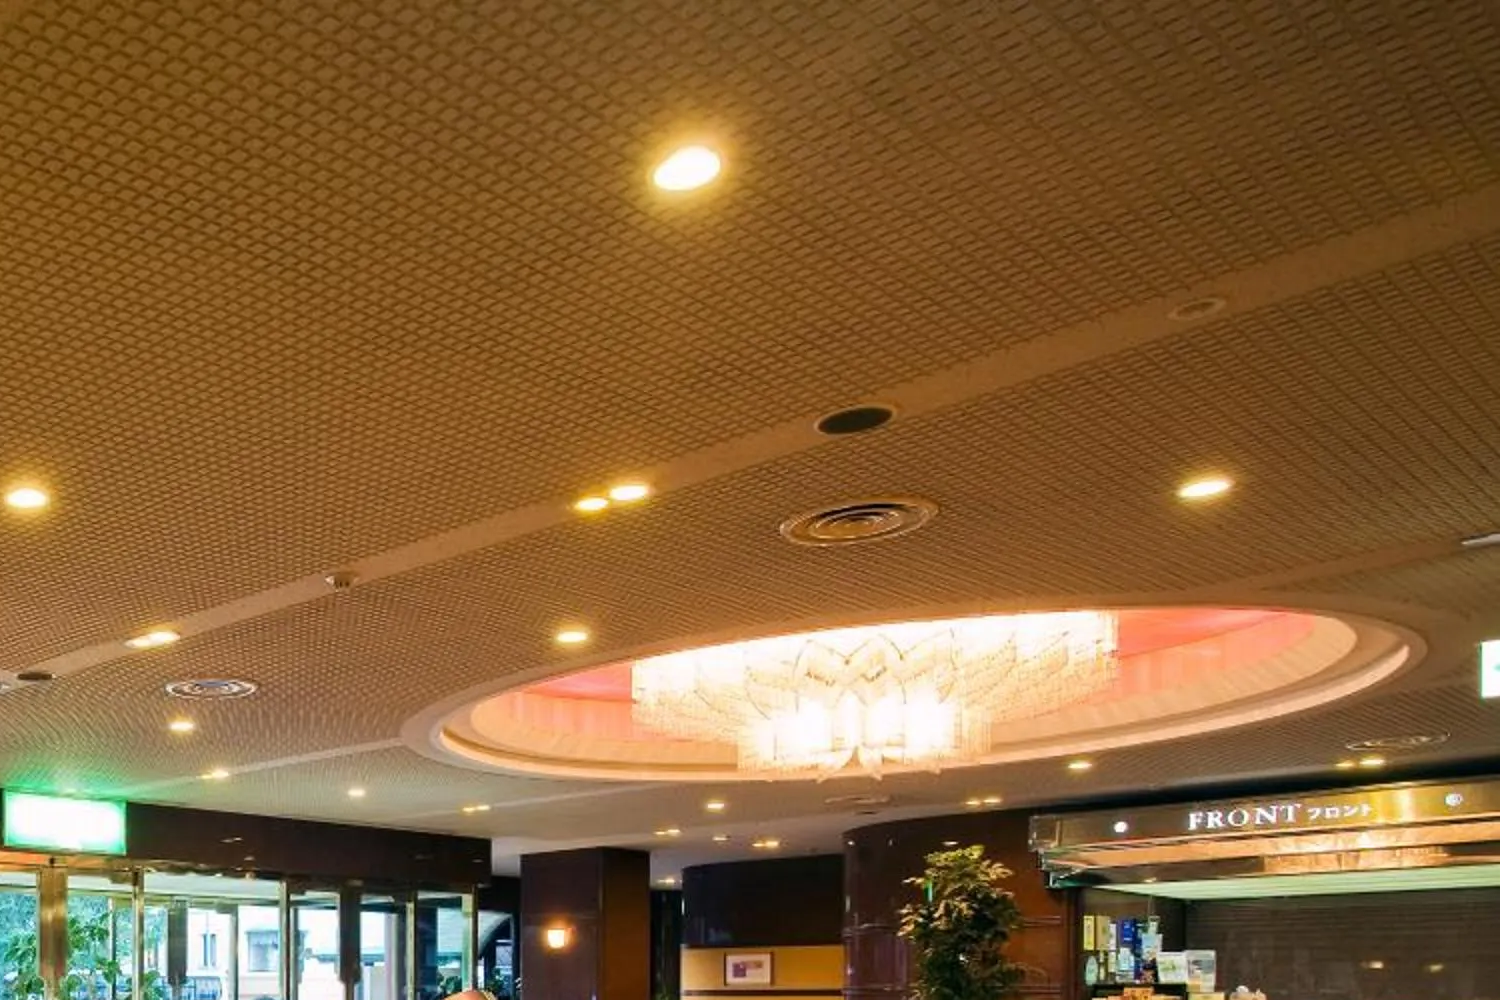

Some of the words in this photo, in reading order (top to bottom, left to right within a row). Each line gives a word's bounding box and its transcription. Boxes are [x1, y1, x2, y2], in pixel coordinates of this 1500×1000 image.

[1188, 803, 1300, 830] FRONT
[1308, 803, 1372, 820] フロント
